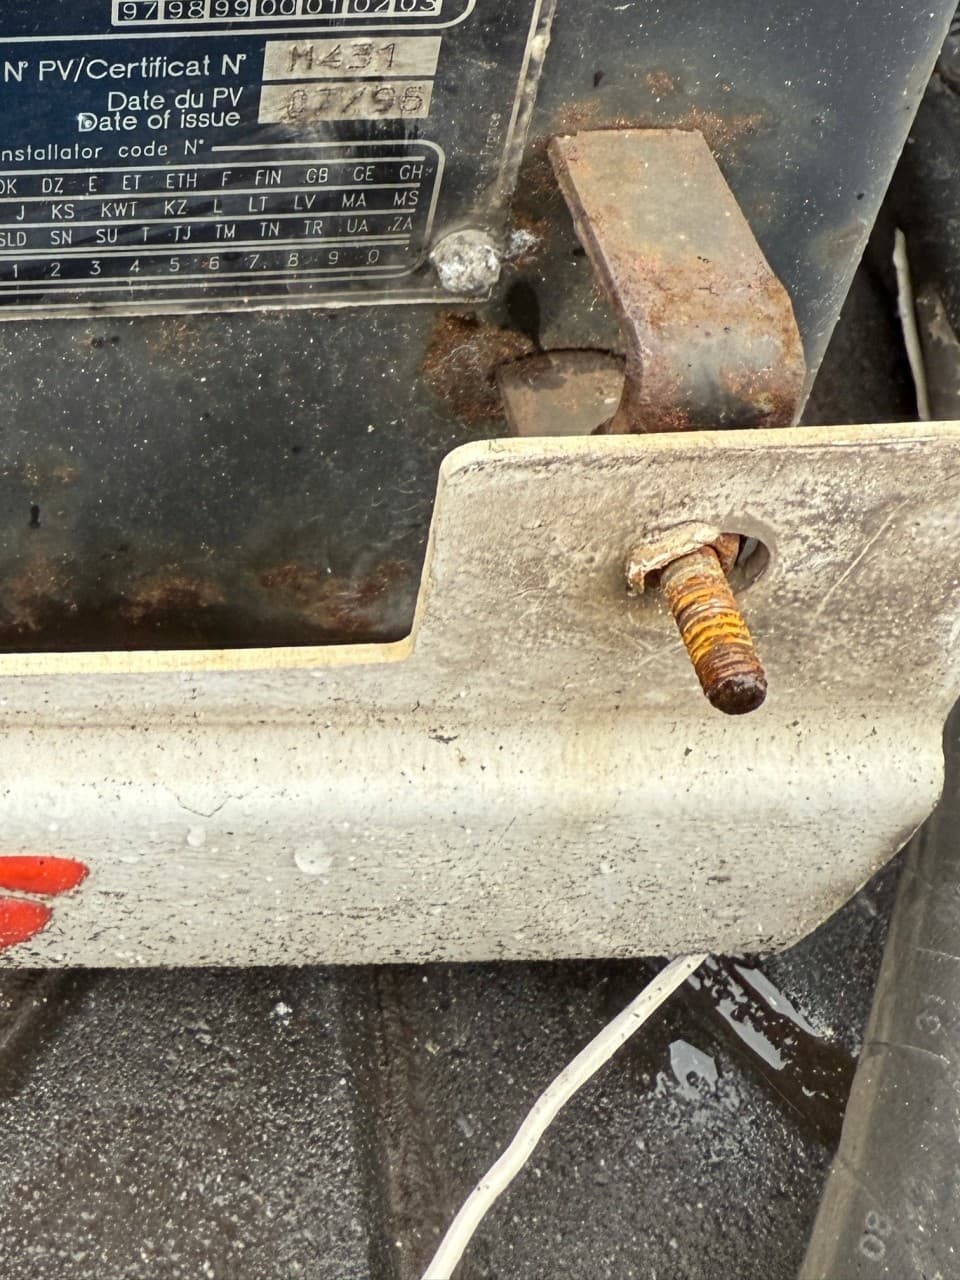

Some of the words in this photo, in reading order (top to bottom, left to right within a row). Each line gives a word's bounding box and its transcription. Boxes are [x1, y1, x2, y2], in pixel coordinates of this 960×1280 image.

[122, 0, 159, 21] 97
[168, 0, 206, 20] 98
[39, 55, 210, 83] PV/Certificat
[107, 90, 165, 112] Date
[174, 88, 204, 110] du
[212, 86, 244, 108] PV
[77, 111, 138, 132] Date
[147, 109, 171, 130] of
[179, 109, 241, 129] issue
[118, 139, 168, 158] code
[42, 177, 64, 194] DZ
[122, 174, 141, 190] ET
[166, 173, 198, 189] ETH
[255, 169, 282, 186] FIN
[306, 167, 329, 184] GB
[353, 165, 376, 182] GE
[399, 164, 423, 180] GH
[51, 204, 75, 219] KS
[100, 201, 138, 218] KWT
[164, 199, 188, 216] KZ
[248, 195, 269, 212] LT
[293, 194, 317, 211] LV
[341, 192, 368, 209] MA
[393, 190, 420, 207] MS
[95, 227, 119, 244] SU
[215, 224, 236, 240] TM
[260, 221, 280, 238] TN
[304, 220, 324, 236] TR
[346, 218, 369, 234] UA
